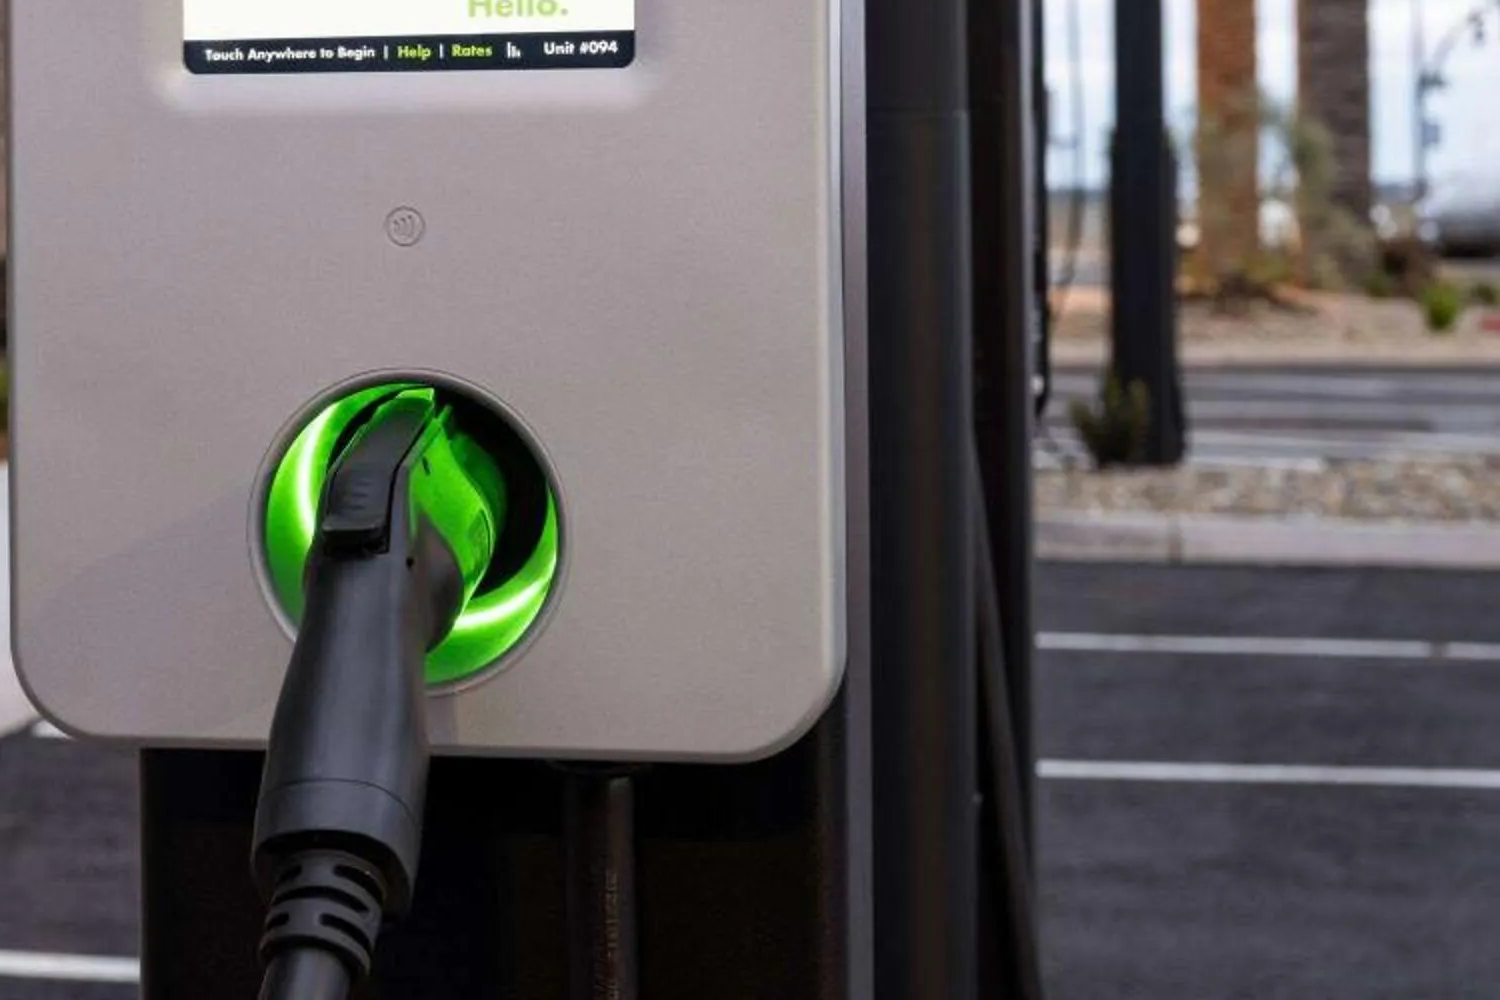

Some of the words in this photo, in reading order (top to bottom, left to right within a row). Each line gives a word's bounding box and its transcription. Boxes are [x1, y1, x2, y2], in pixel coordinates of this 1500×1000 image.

[205, 48, 243, 62] Touch
[247, 47, 316, 63] Anywhere
[320, 47, 334, 59] to
[337, 45, 375, 61] Begin
[397, 44, 431, 61] Help
[452, 43, 493, 58] Rates
[543, 41, 575, 55] Unit
[579, 39, 619, 55] #094
